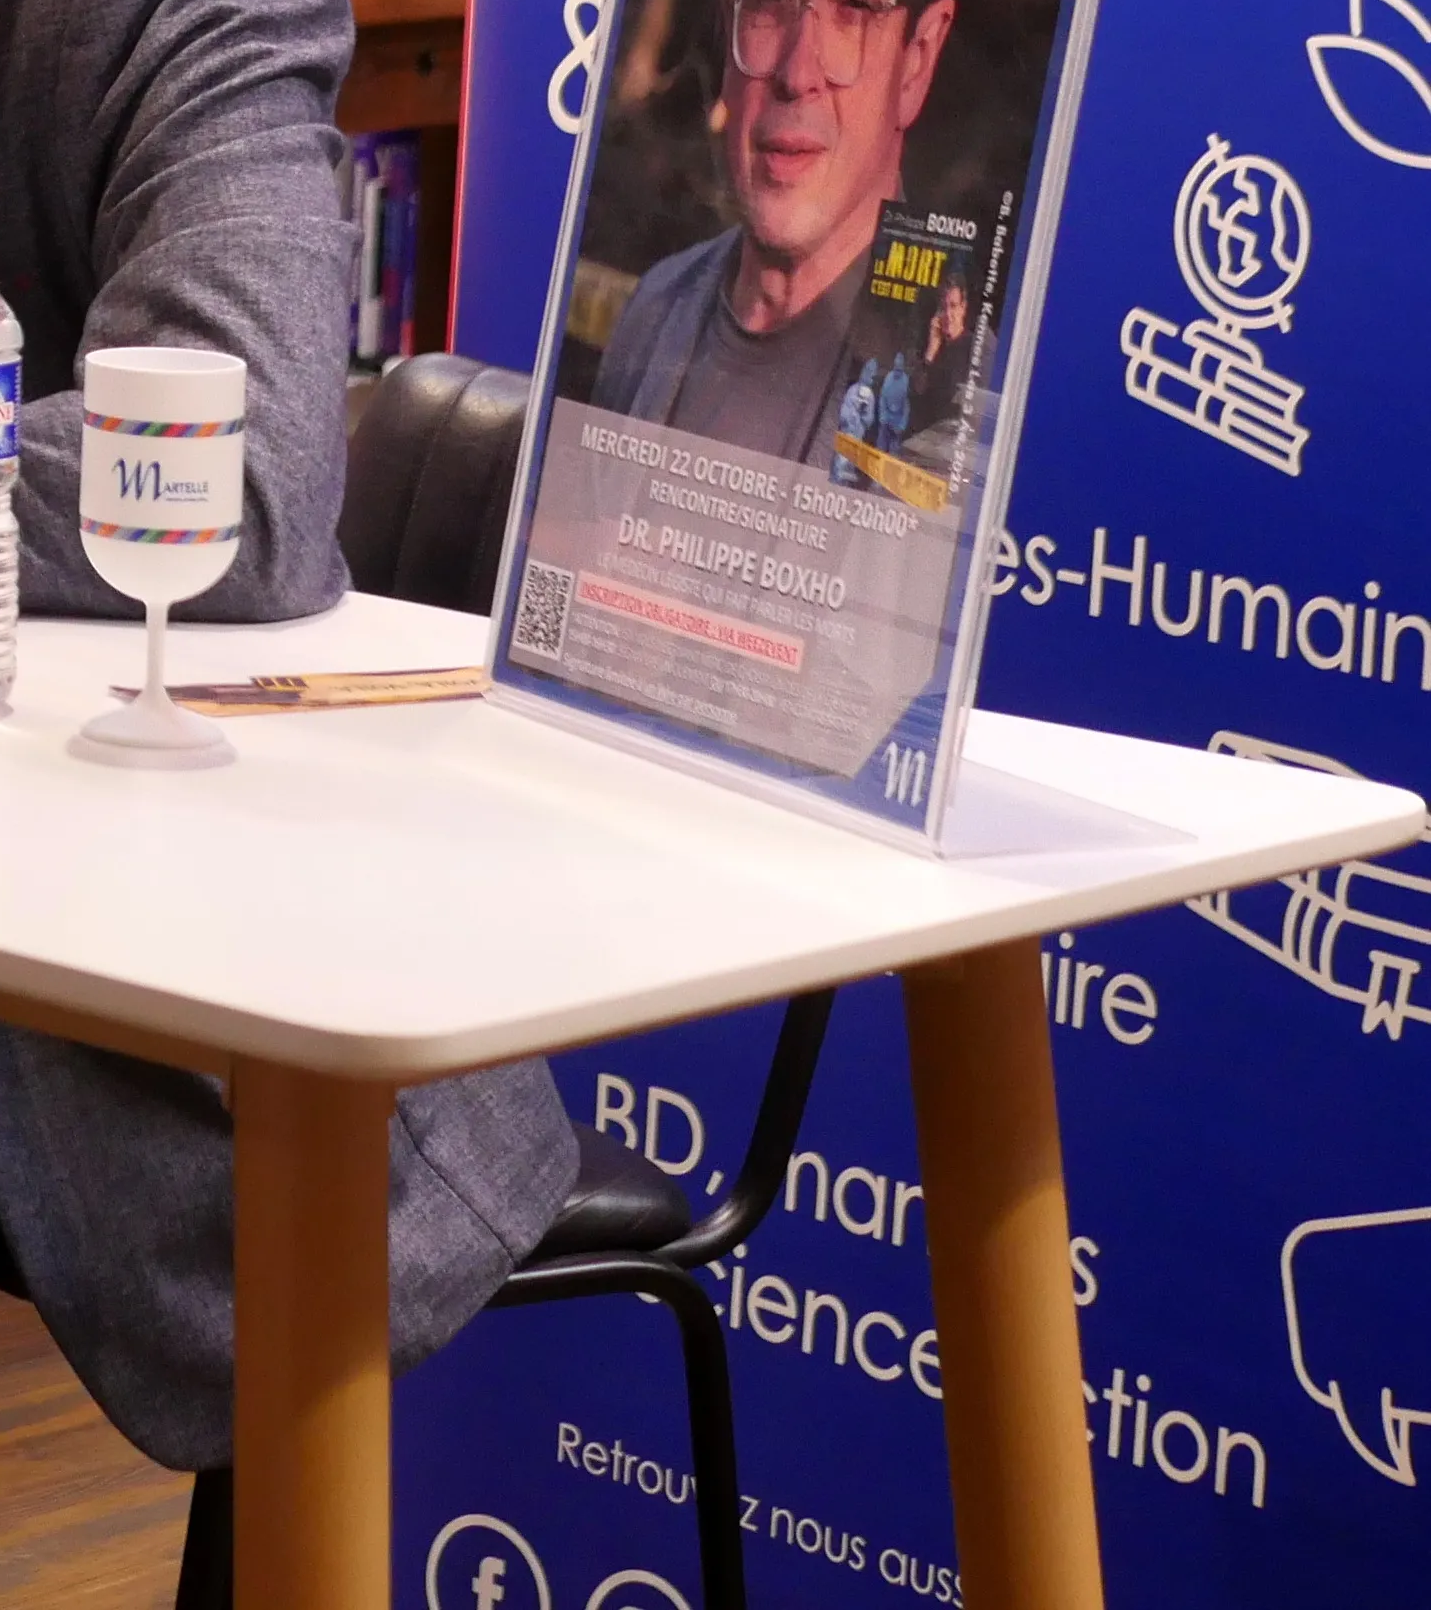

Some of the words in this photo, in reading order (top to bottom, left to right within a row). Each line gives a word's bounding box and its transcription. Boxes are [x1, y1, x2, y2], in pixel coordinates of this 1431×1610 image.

[885, 240, 948, 288] MORT
[926, 212, 978, 241] BOXHO
[580, 422, 667, 470] MERCREDI
[669, 448, 692, 478] 22
[693, 455, 779, 502] OCTOBRE
[658, 524, 757, 586] PHILIPPE
[759, 553, 847, 612] BOXHO
[983, 525, 1431, 692] es-Humain
[595, 1072, 725, 1196] BD,
[556, 1421, 760, 1533] Retrouz
[770, 1504, 868, 1572] nous
